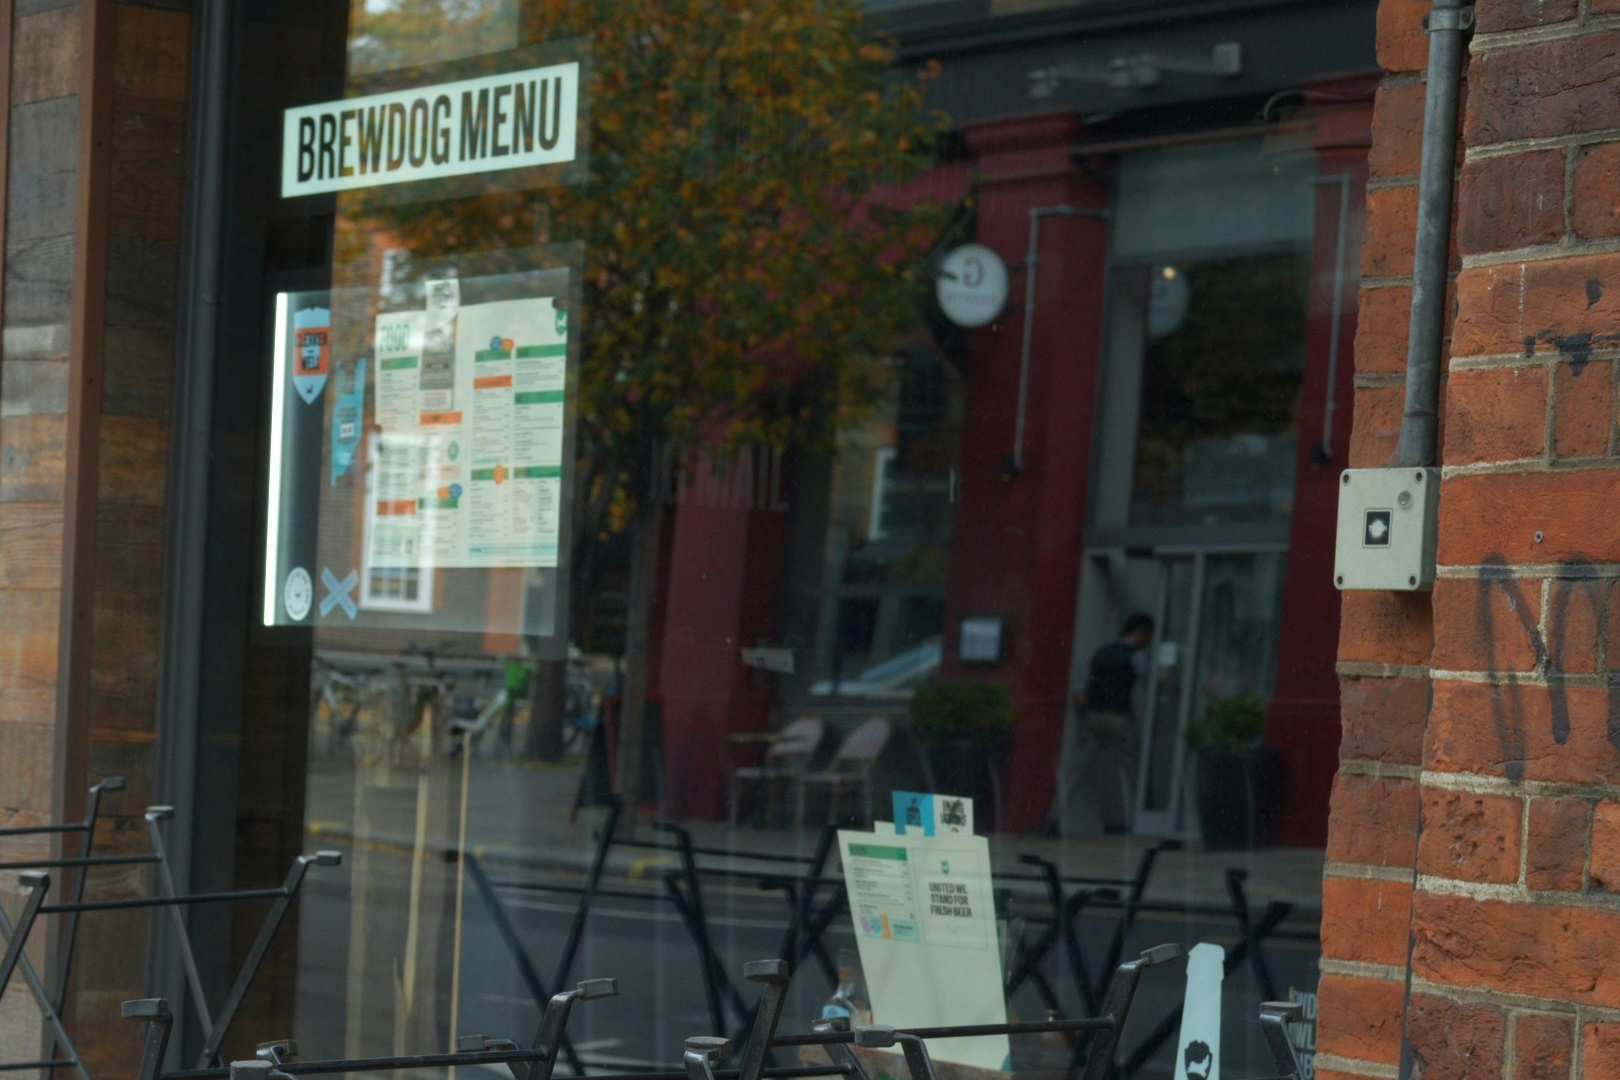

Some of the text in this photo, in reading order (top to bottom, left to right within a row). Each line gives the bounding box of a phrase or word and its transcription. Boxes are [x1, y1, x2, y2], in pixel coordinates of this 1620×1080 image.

[297, 76, 562, 183] BREWDOG MENU
[929, 882, 968, 895] UNITED WE
[931, 893, 969, 907] STAND FOR
[930, 904, 972, 918] FRESH BEER
